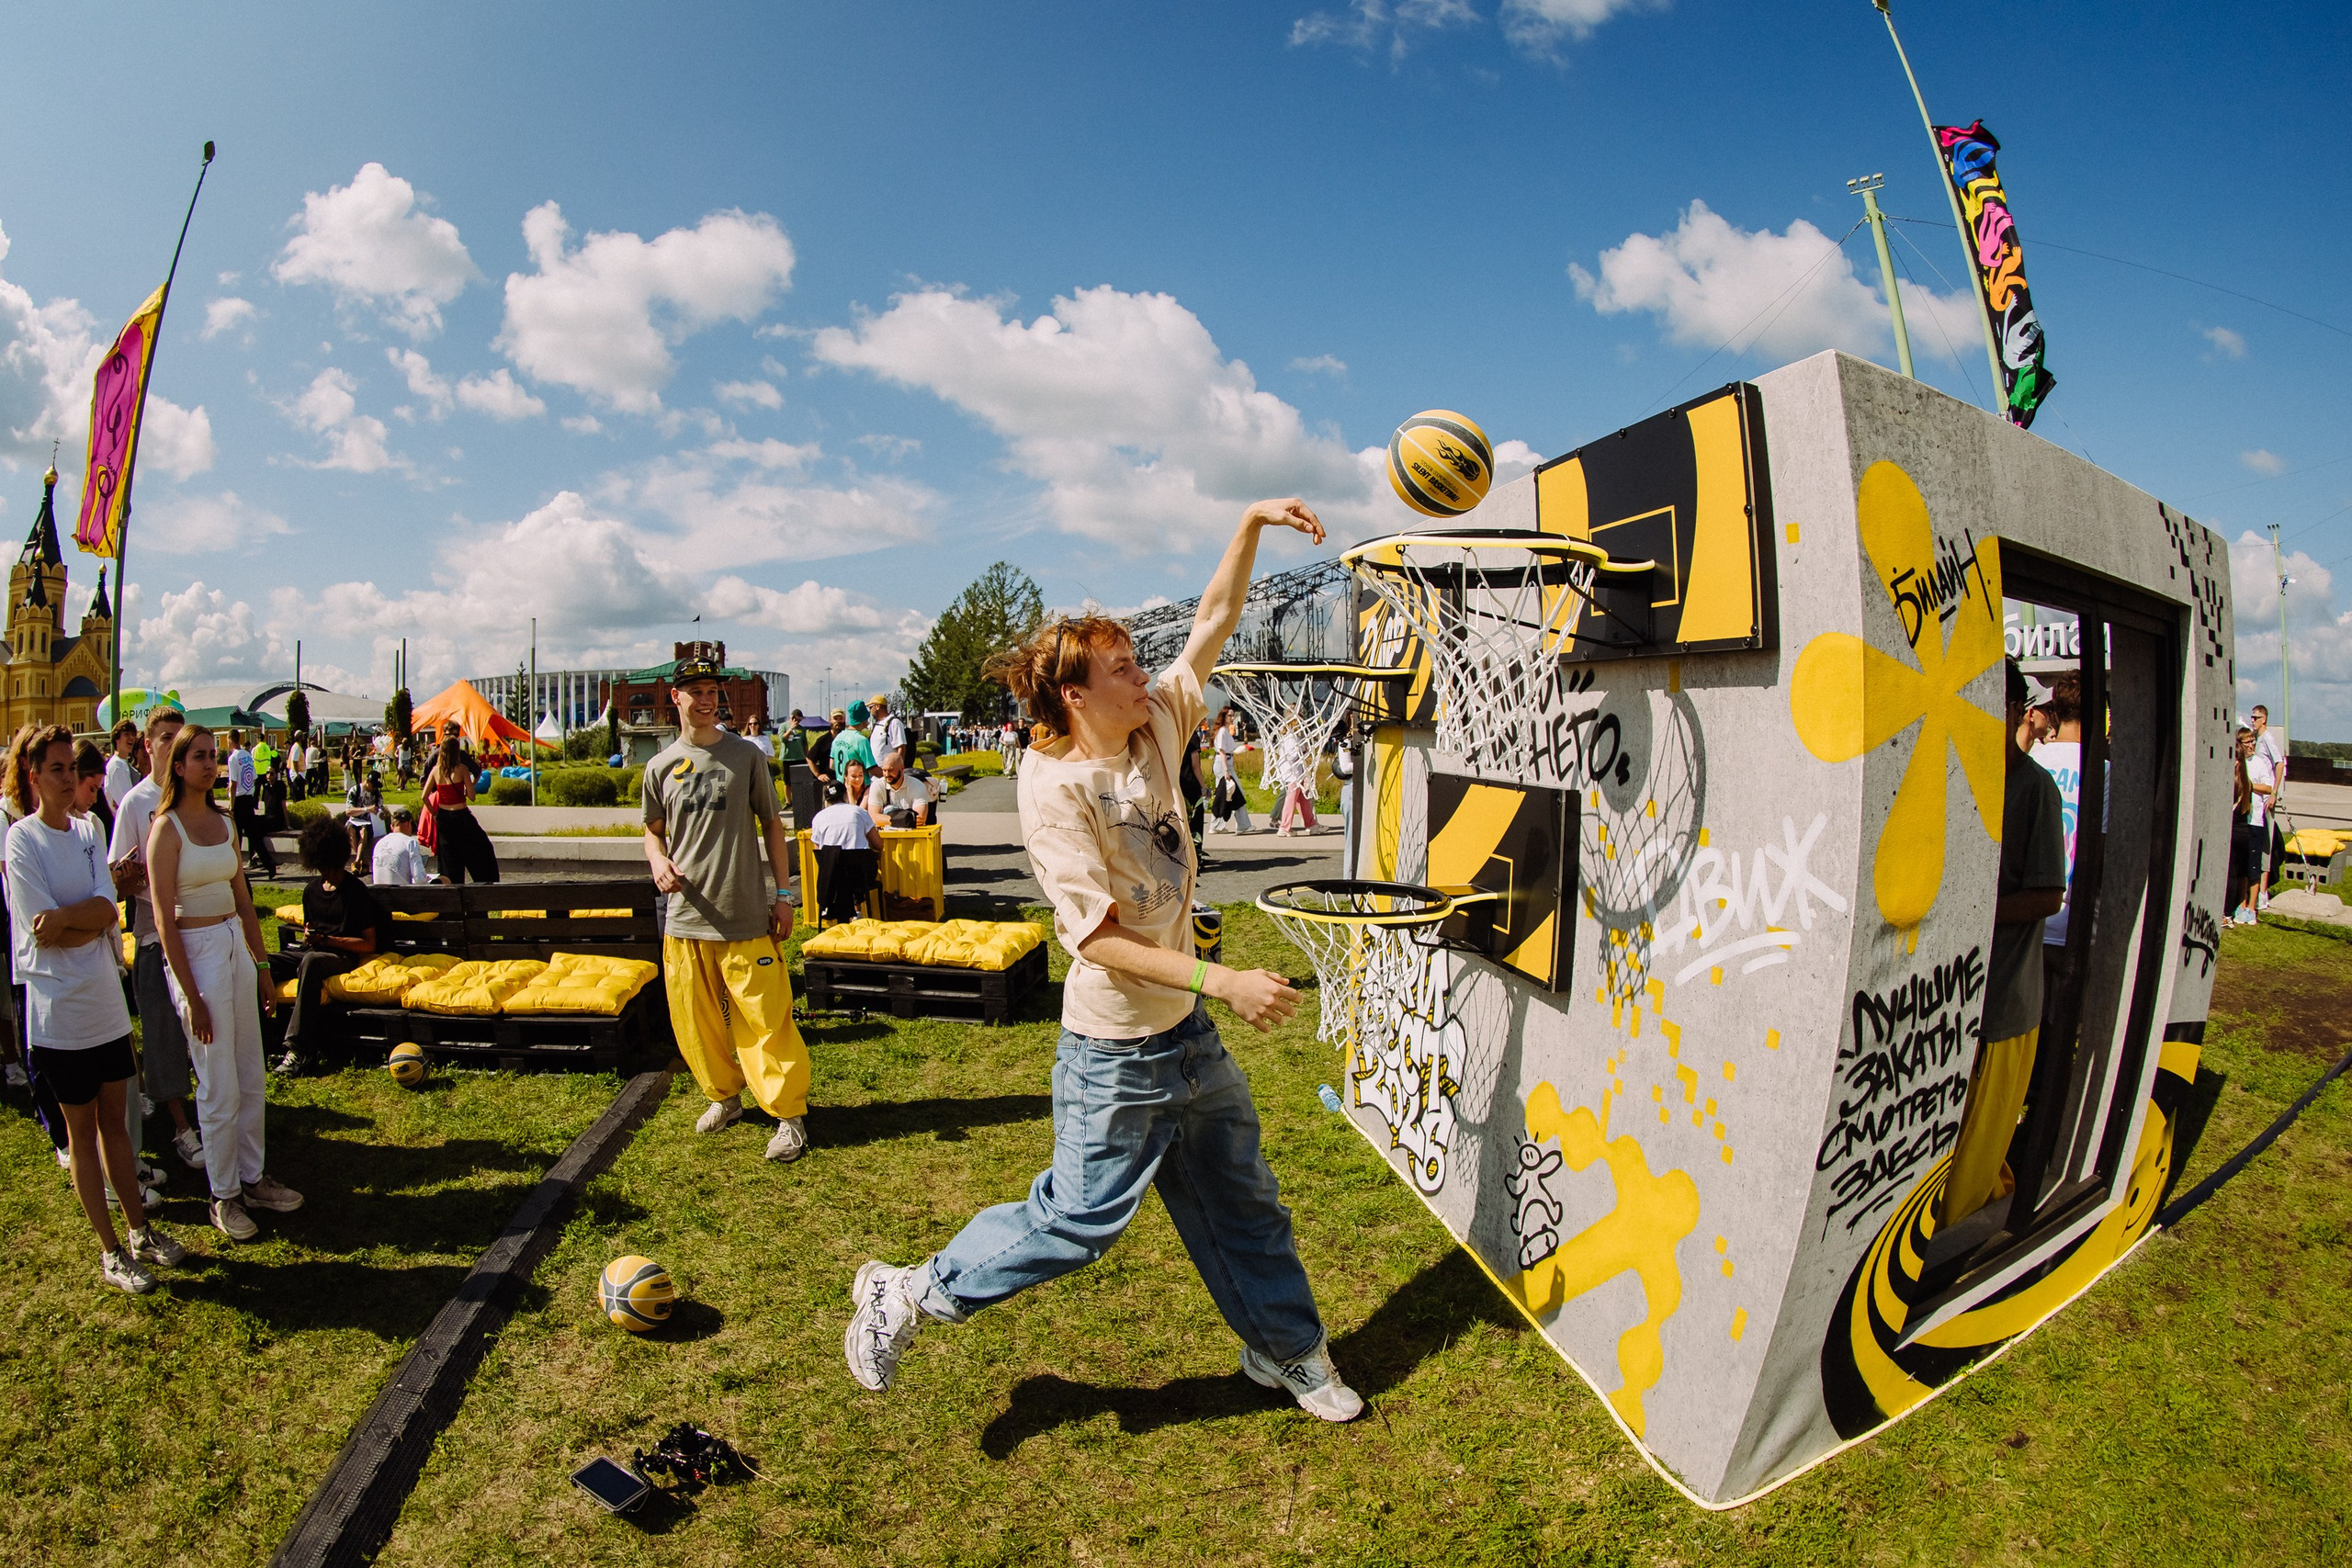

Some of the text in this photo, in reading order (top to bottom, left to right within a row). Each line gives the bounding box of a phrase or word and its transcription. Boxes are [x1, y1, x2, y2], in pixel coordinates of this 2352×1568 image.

[1411, 462, 1431, 479] SILENT
[1428, 476, 1461, 502] BASKETBALL
[1851, 945, 1985, 1056] ЛУЧШИЕ
[1839, 1011, 1962, 1118] ЗАКАТЫ
[1815, 1071, 1968, 1172] СМОТРЕТЬ
[1826, 1119, 1960, 1218] ЗДЕСЬ
